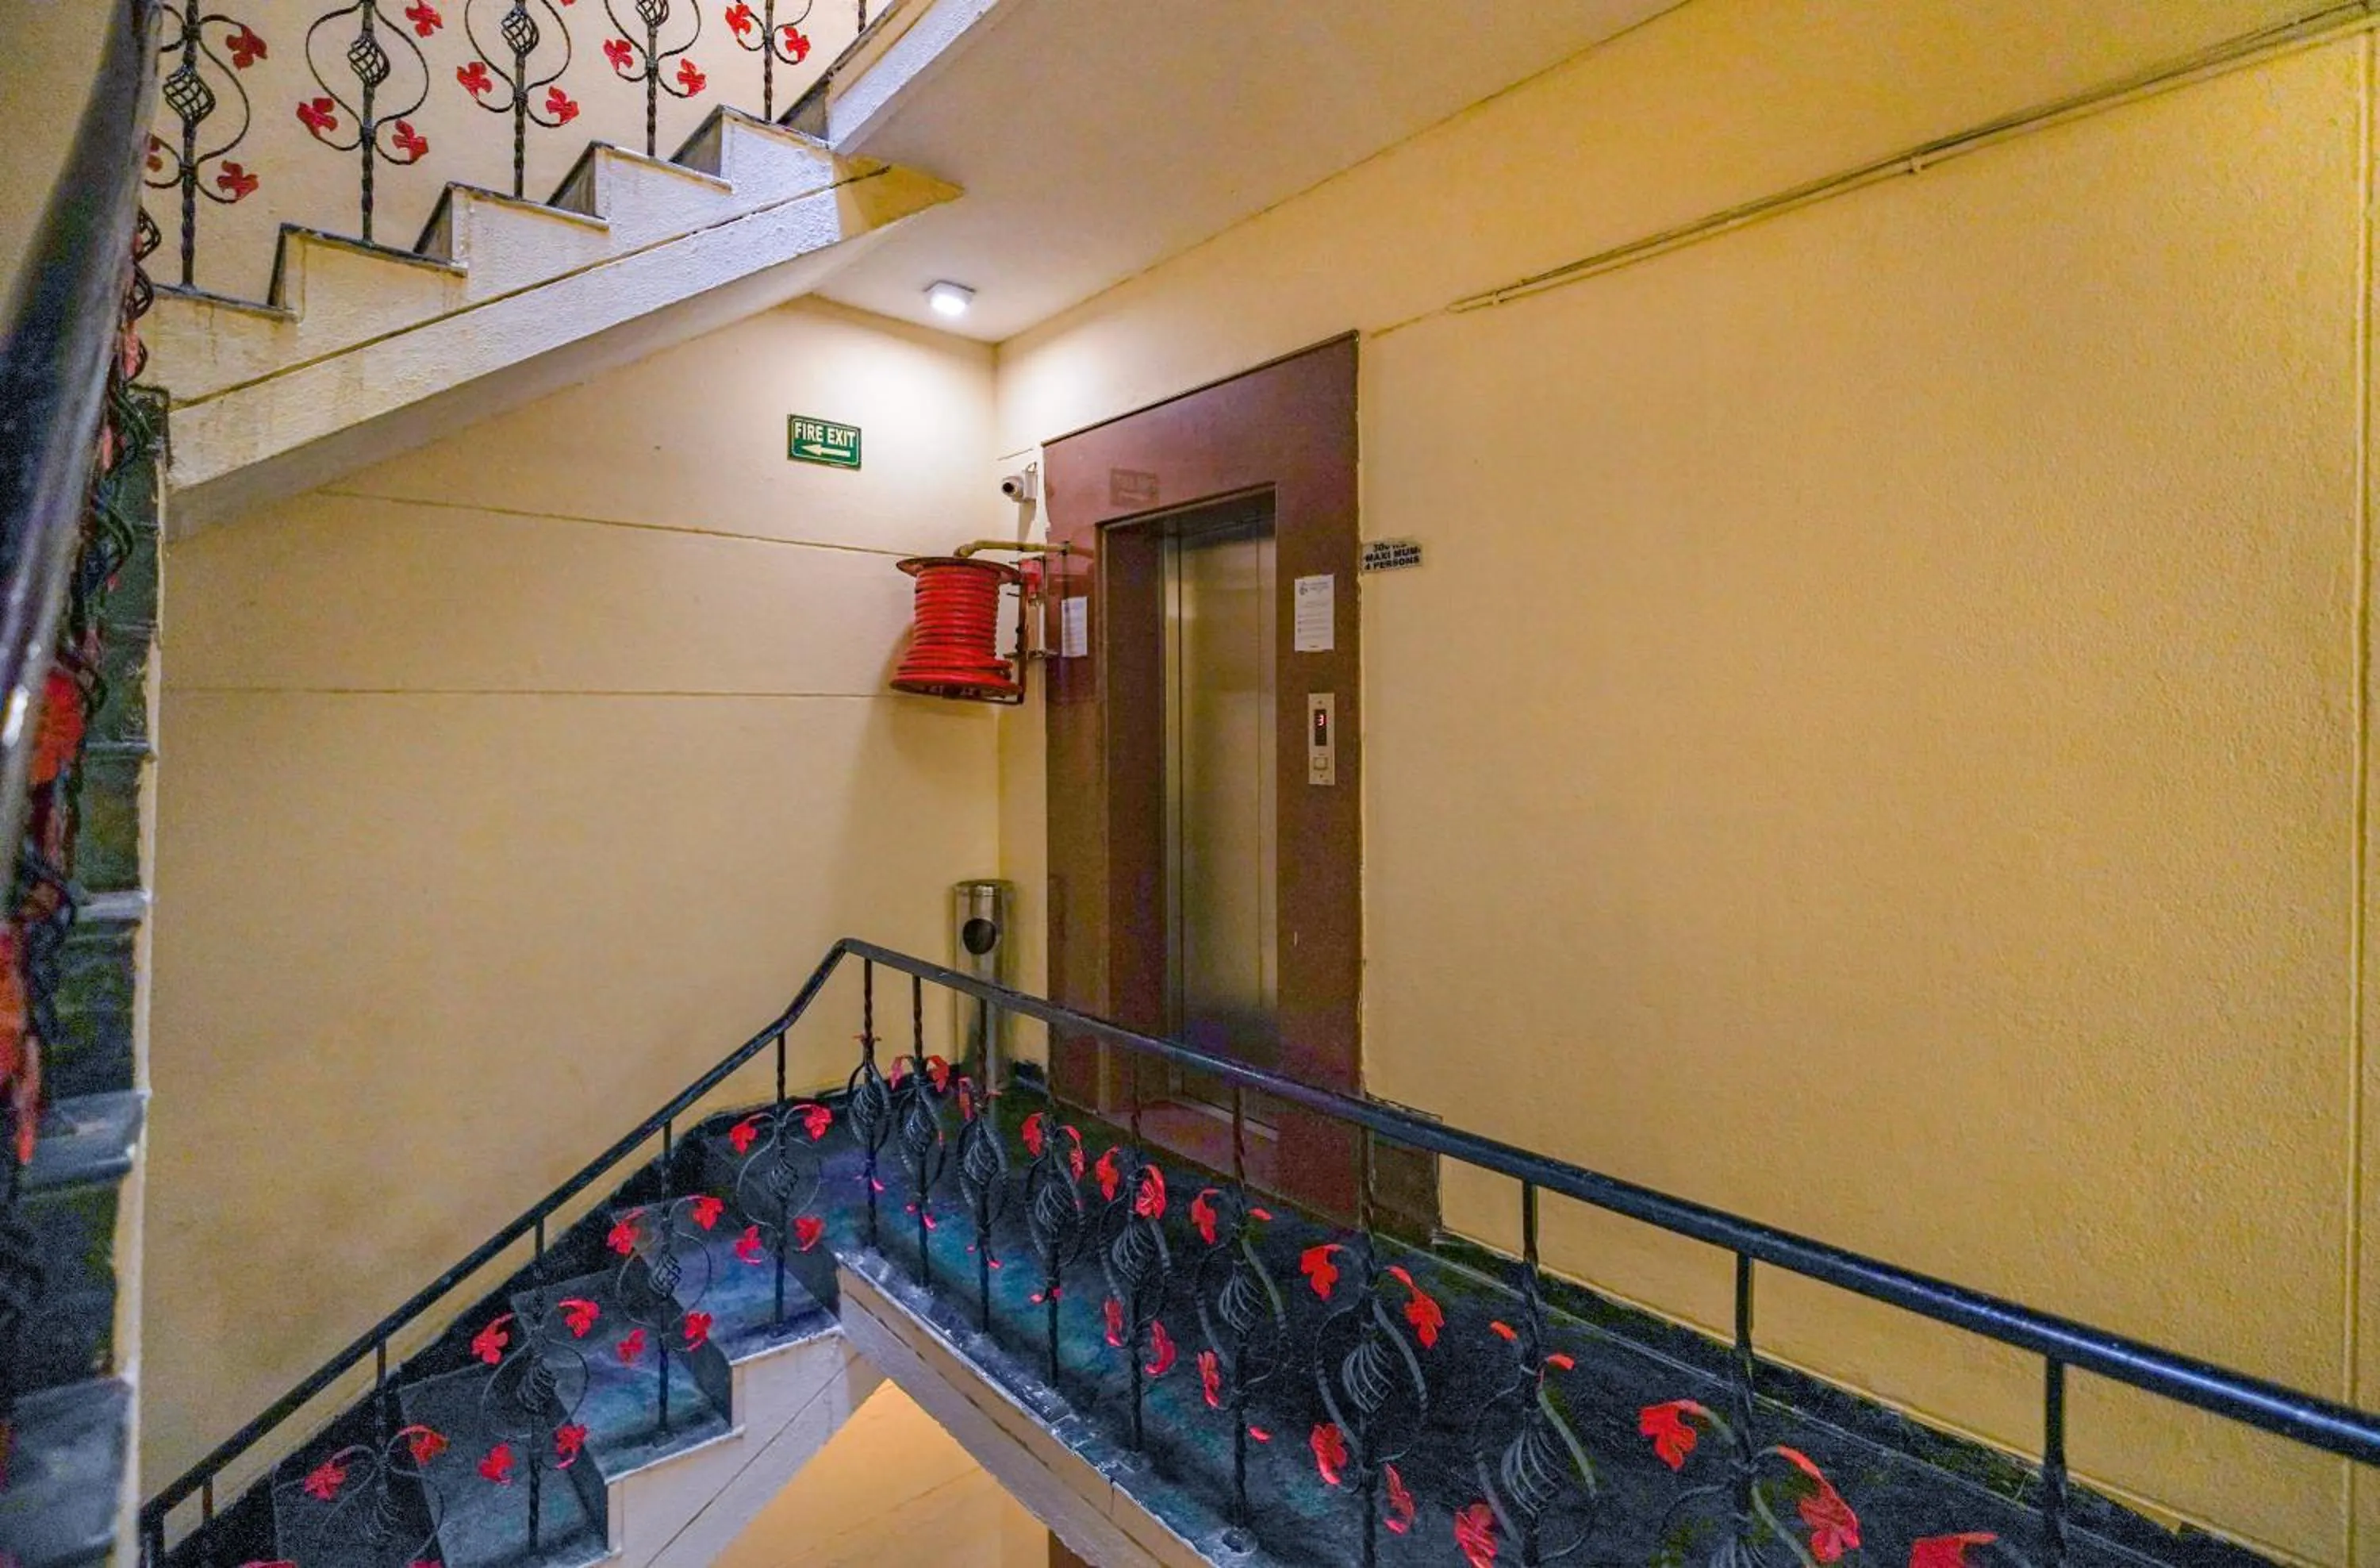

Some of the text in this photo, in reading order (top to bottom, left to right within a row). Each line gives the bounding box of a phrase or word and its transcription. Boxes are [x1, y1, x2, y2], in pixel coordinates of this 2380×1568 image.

[794, 421, 855, 448] FIRE EXIT
[1373, 555, 1420, 569] PERSONS
[1318, 714, 1324, 726] 3
